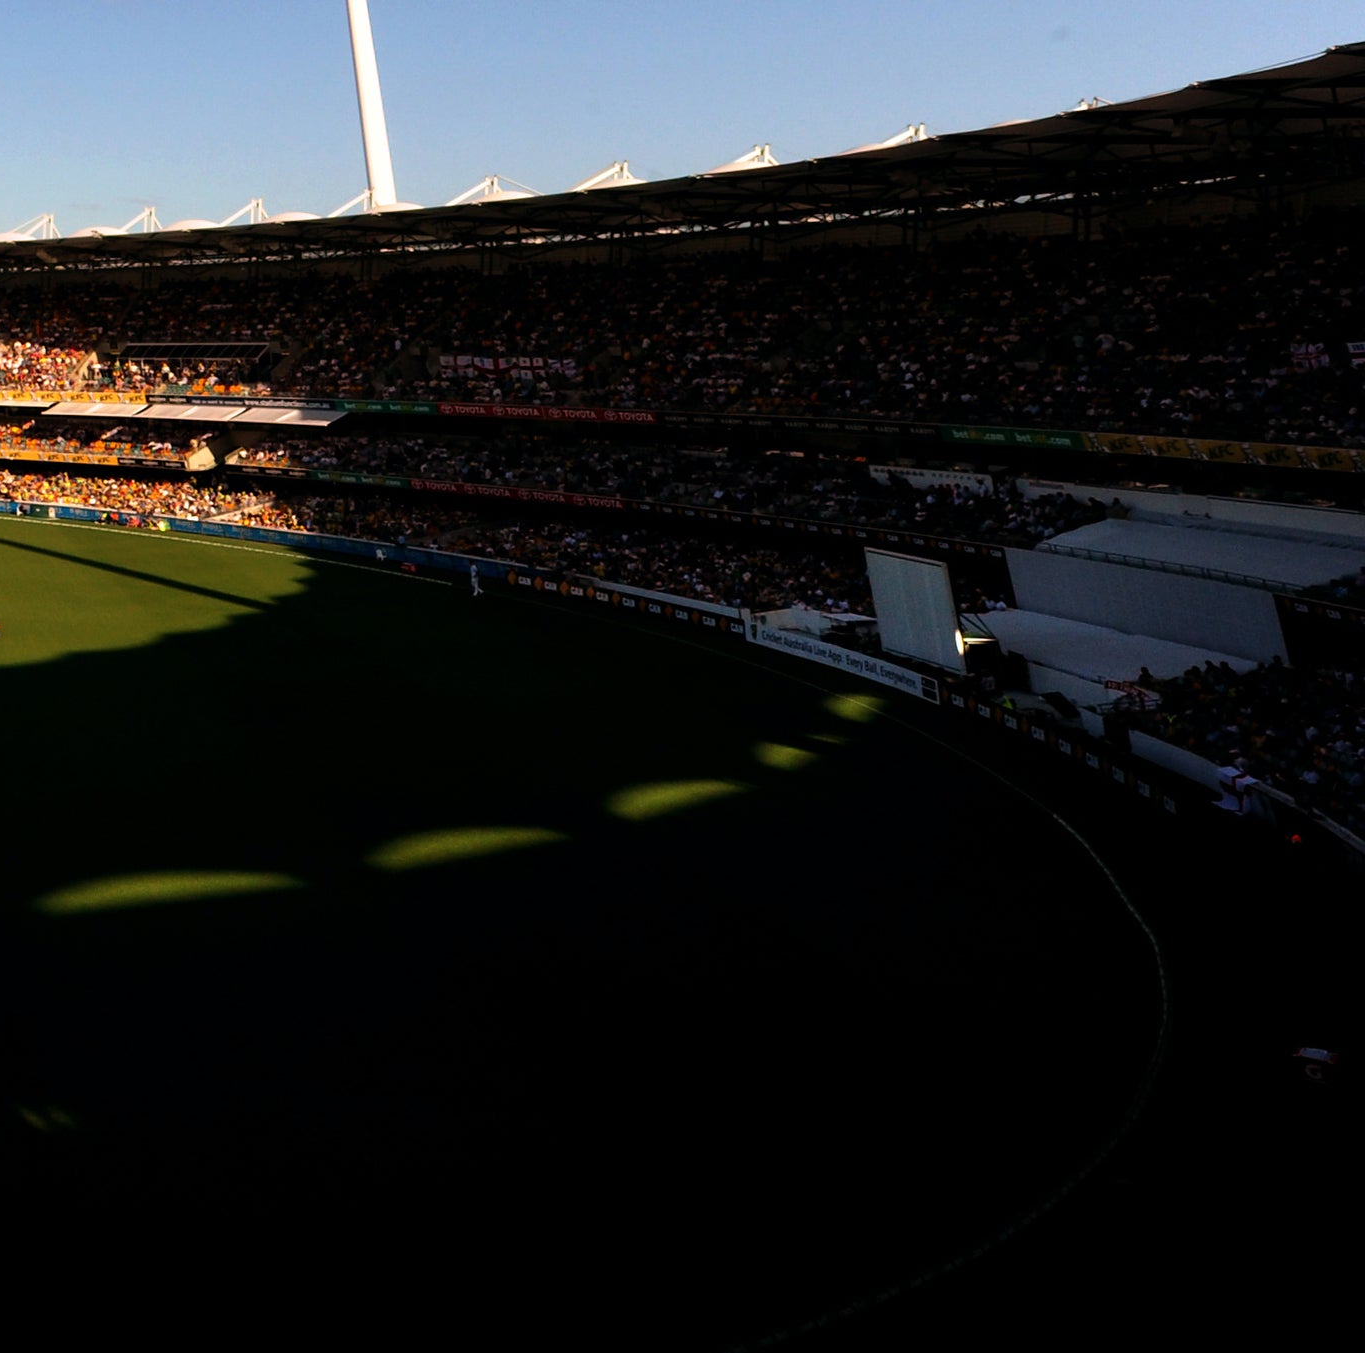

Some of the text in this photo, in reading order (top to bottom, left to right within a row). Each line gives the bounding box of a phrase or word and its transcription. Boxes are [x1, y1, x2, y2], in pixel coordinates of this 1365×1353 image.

[70, 393, 85, 401] KFC
[129, 394, 144, 402] KFC
[455, 405, 486, 415] TOYOTA
[508, 406, 540, 417] TOYOTA
[564, 409, 597, 420] TOYOTA
[618, 410, 653, 423] TOYOTA
[1109, 436, 1131, 447] KFC
[1157, 439, 1179, 453] KFC
[1210, 444, 1235, 456] KFC
[1264, 448, 1291, 461] KFC
[1319, 451, 1343, 466] KFC
[426, 481, 457, 492] TOYOTA
[478, 486, 510, 497] TOYOTA
[533, 491, 565, 504] TOYOTA
[588, 497, 622, 509] TOYOTA
[762, 629, 783, 644] Cricket
